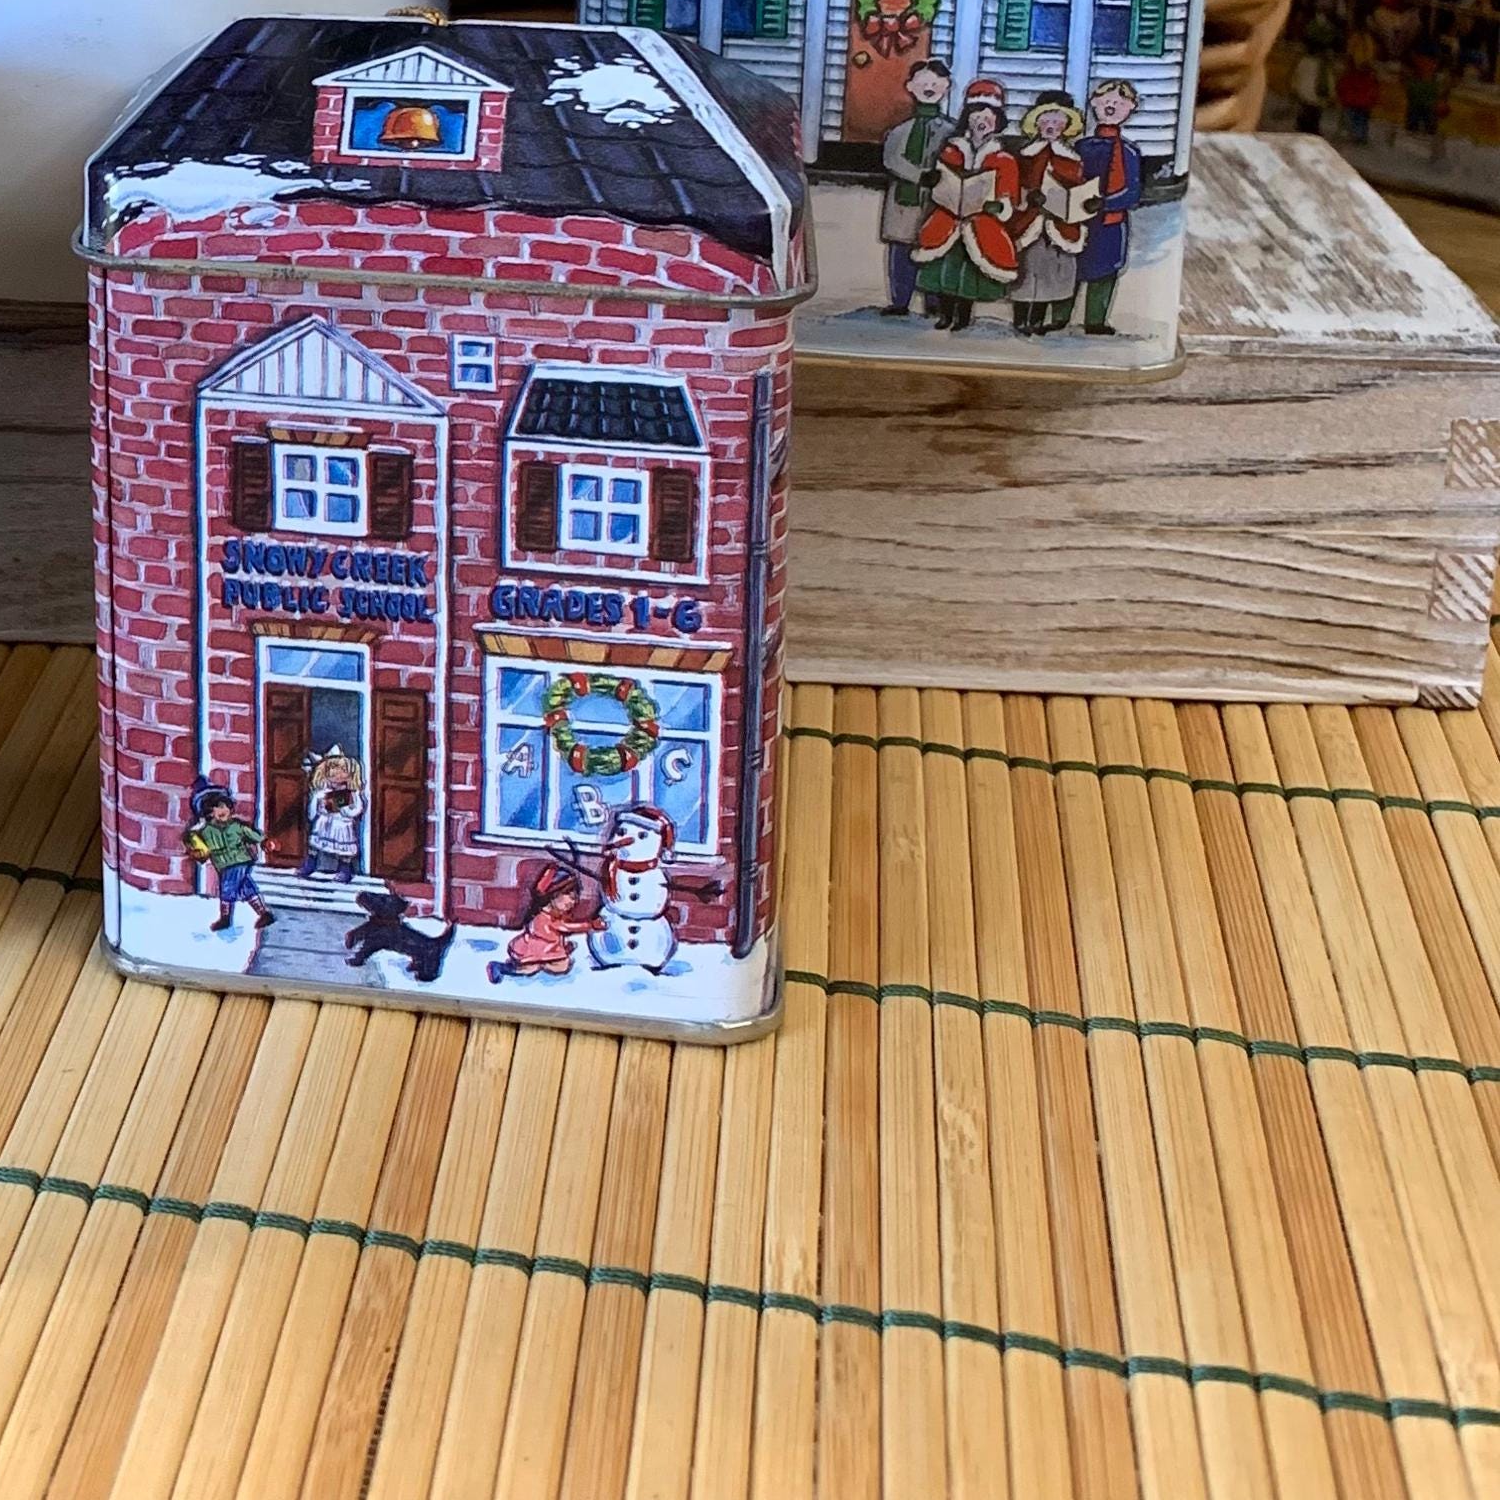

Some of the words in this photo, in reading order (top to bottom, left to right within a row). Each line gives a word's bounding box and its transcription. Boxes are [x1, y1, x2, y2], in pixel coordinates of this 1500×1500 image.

[220, 536, 328, 580] SNOWY
[331, 543, 429, 588] CREEK
[221, 575, 330, 615] PUBLIC
[337, 581, 437, 624] SCHOOL
[489, 577, 627, 628] GRADES
